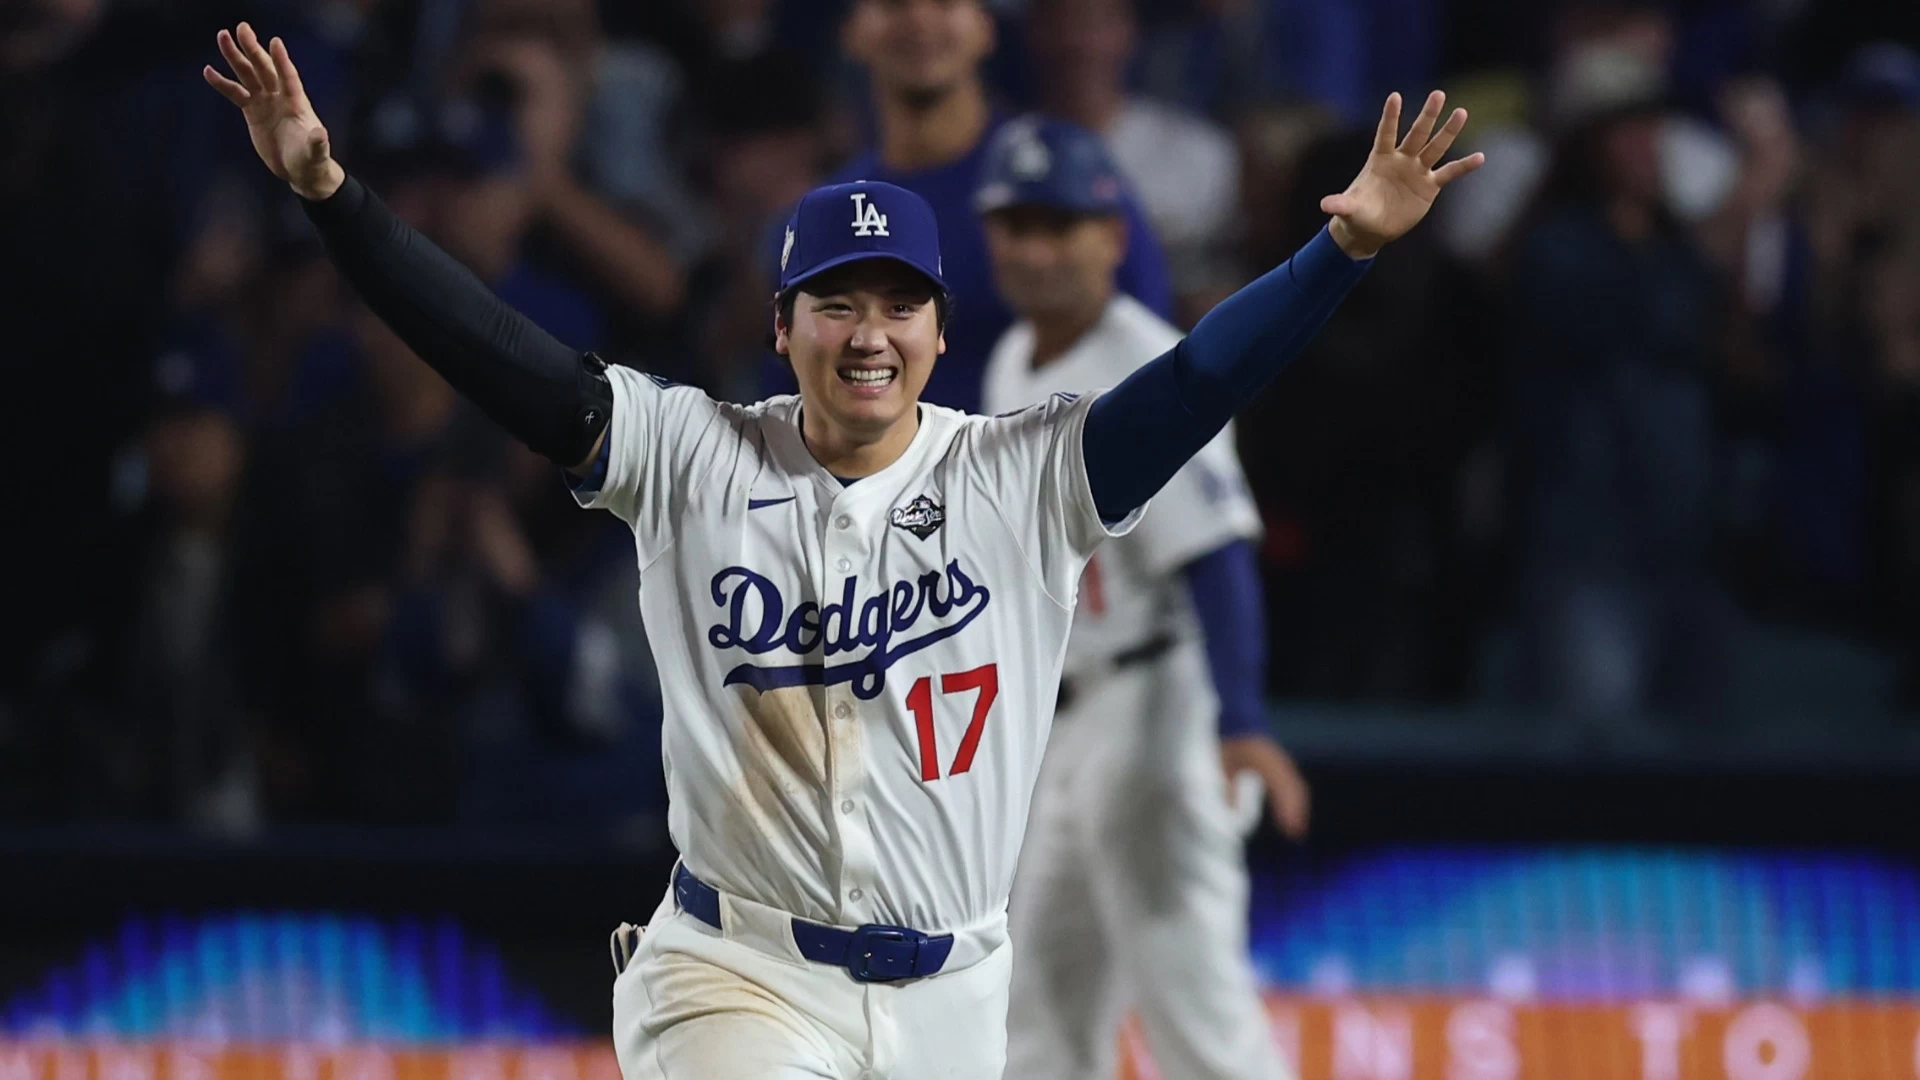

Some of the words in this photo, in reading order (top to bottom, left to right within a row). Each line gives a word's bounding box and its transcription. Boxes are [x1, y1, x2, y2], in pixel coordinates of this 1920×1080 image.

[850, 193, 890, 237] LA
[708, 558, 991, 701] Dodgers
[905, 663, 999, 782] 17
